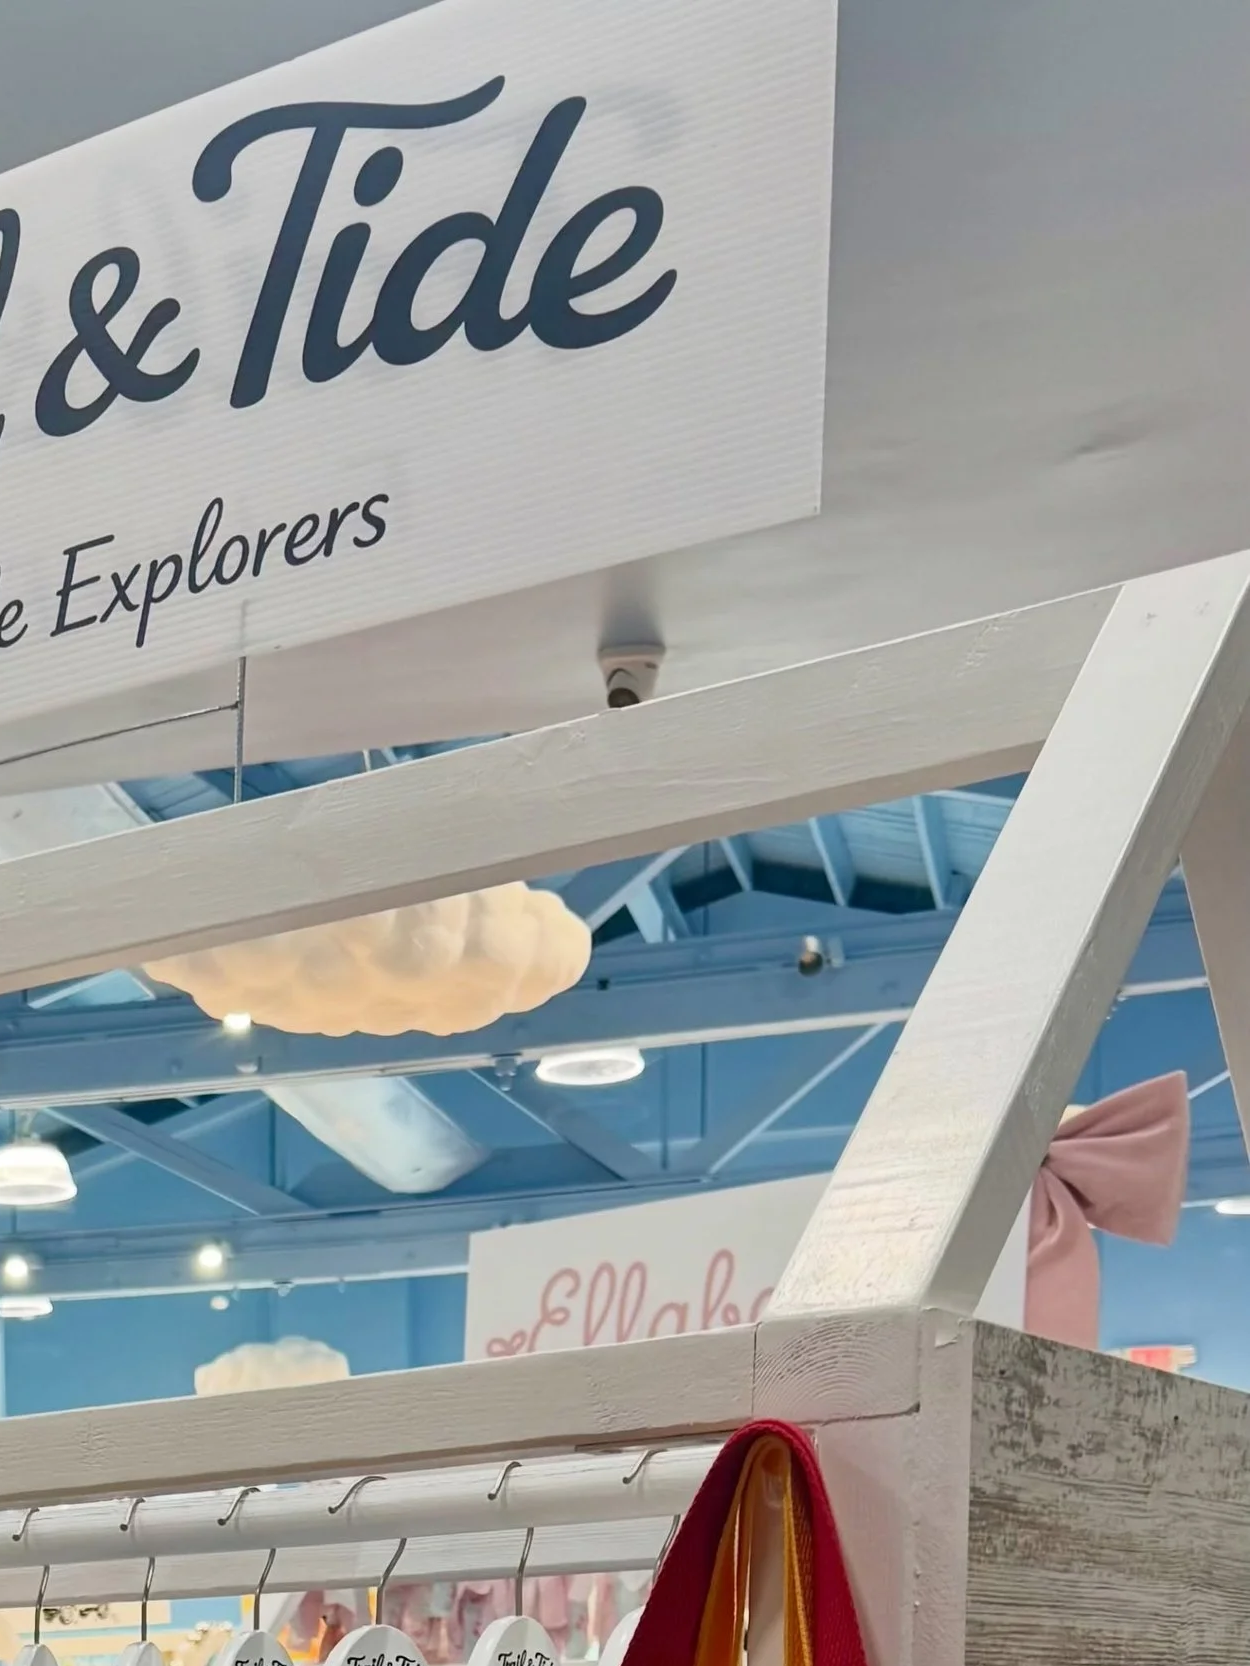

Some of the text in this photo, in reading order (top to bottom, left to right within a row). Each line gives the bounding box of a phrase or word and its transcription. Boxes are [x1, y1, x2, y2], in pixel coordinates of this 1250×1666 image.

[33, 246, 200, 437] &
[192, 76, 678, 408] Tide
[50, 492, 390, 648] Explorers
